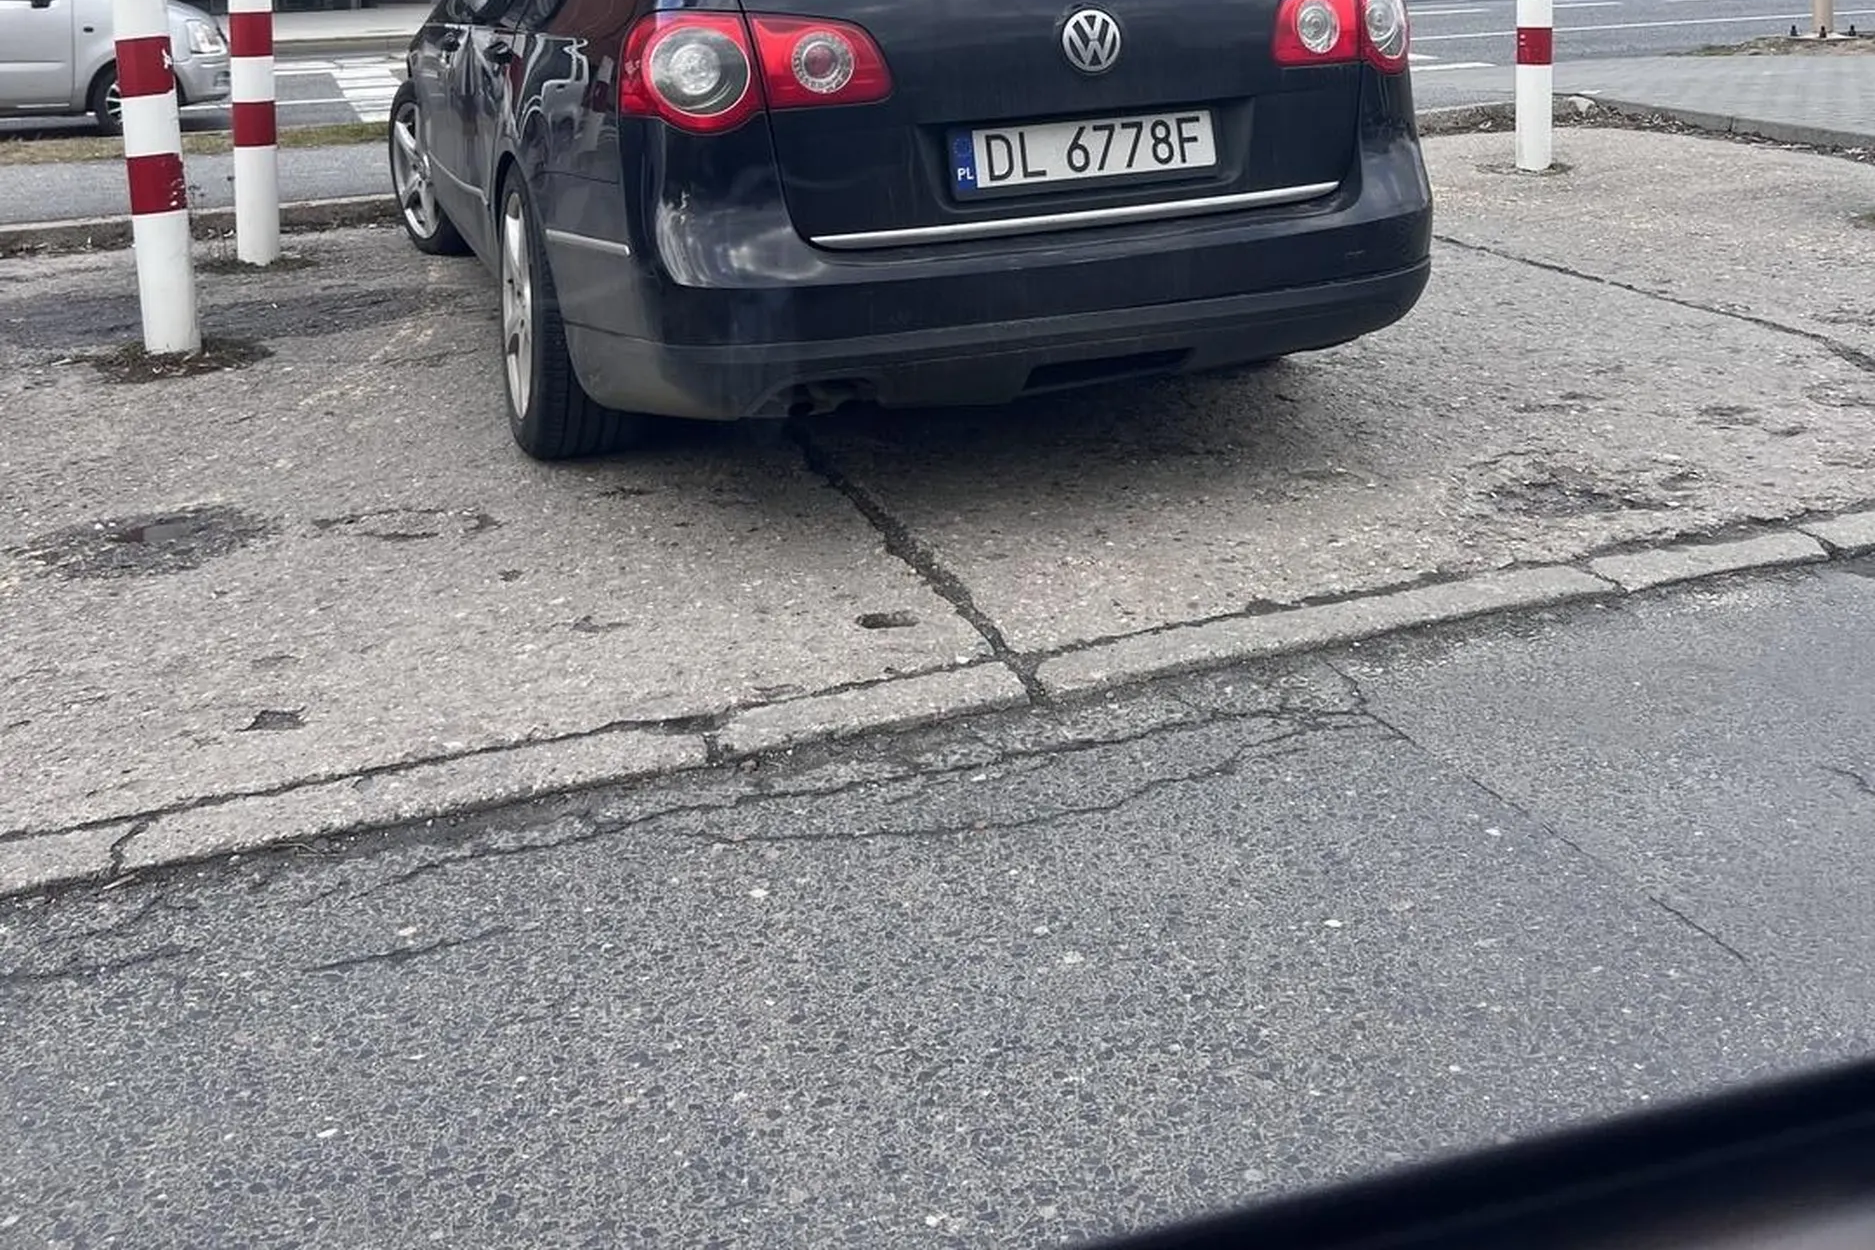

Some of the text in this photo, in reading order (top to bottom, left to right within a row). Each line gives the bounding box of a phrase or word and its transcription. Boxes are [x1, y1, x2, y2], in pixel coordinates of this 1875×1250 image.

[985, 116, 1200, 183] DL 6778F
[957, 167, 975, 181] PL
